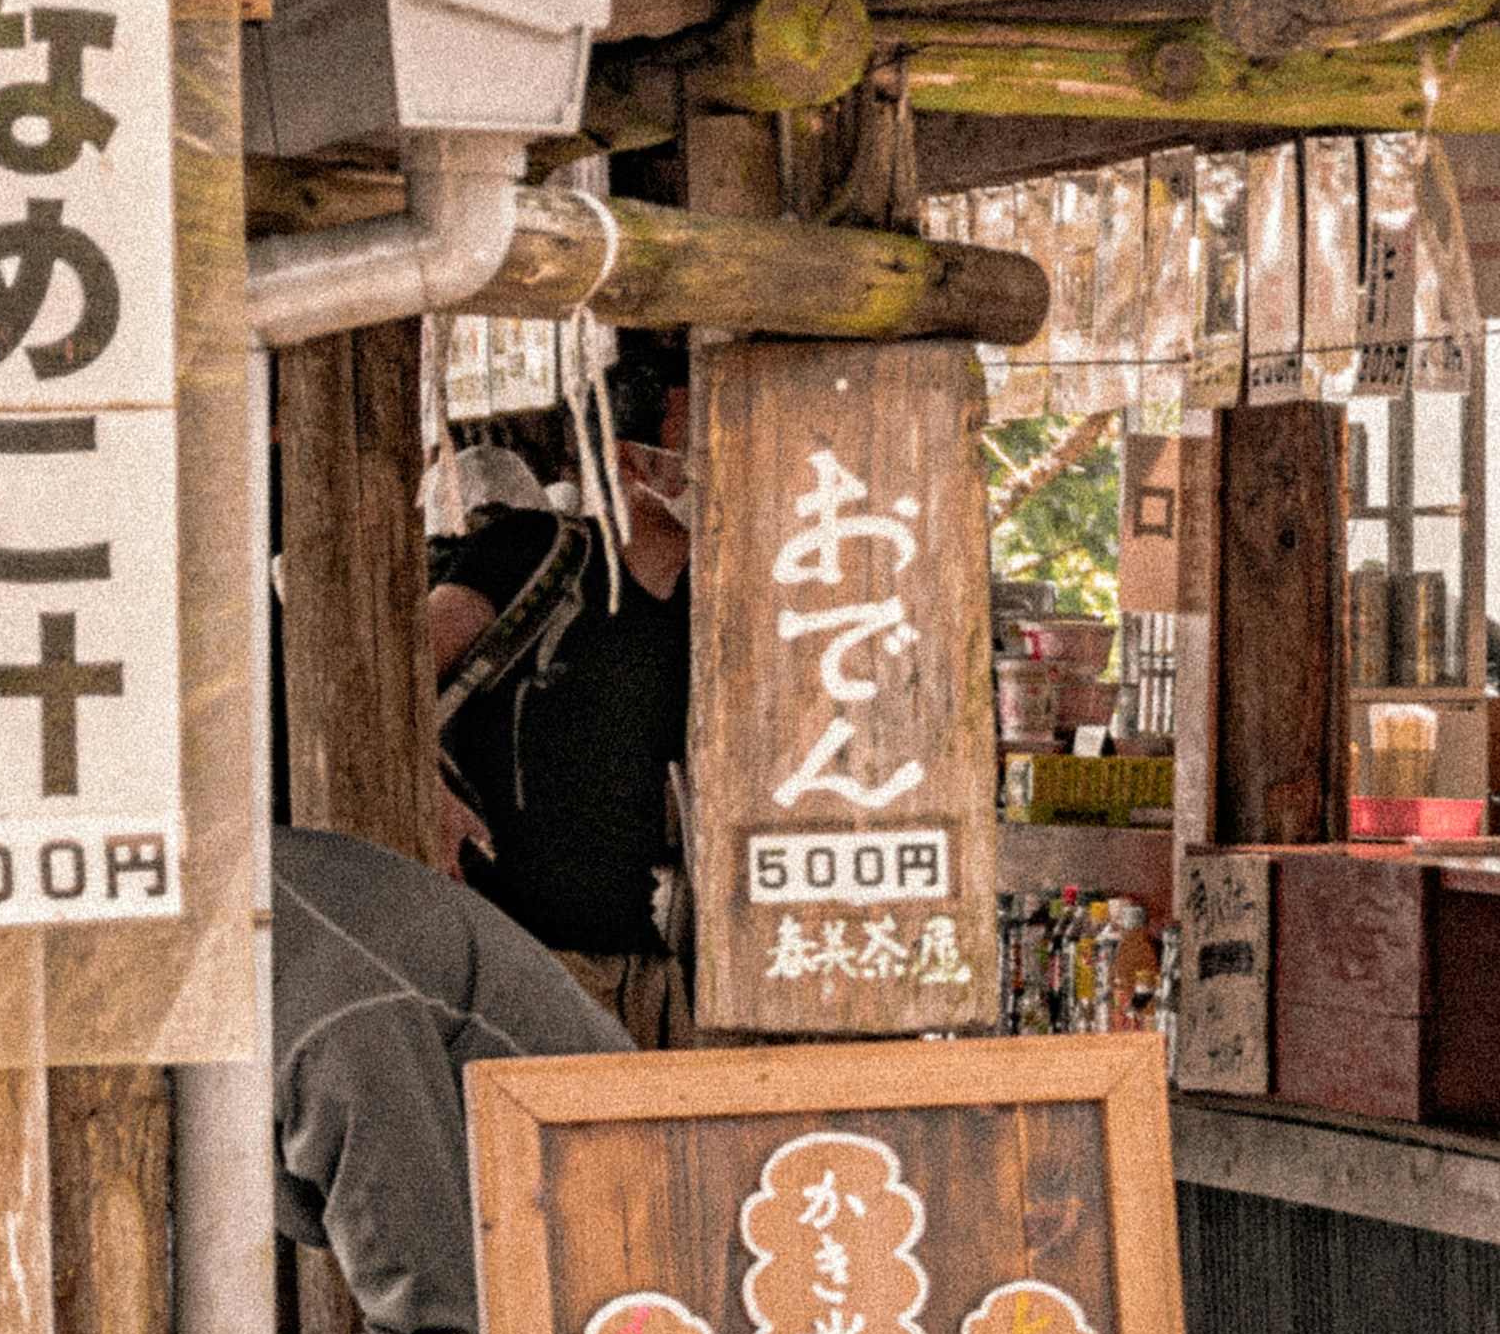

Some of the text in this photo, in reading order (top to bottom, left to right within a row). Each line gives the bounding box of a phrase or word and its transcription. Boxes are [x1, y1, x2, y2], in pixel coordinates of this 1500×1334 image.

[772, 449, 926, 809] おでん
[757, 841, 941, 891] 500円
[765, 913, 973, 985] 春美茶屋
